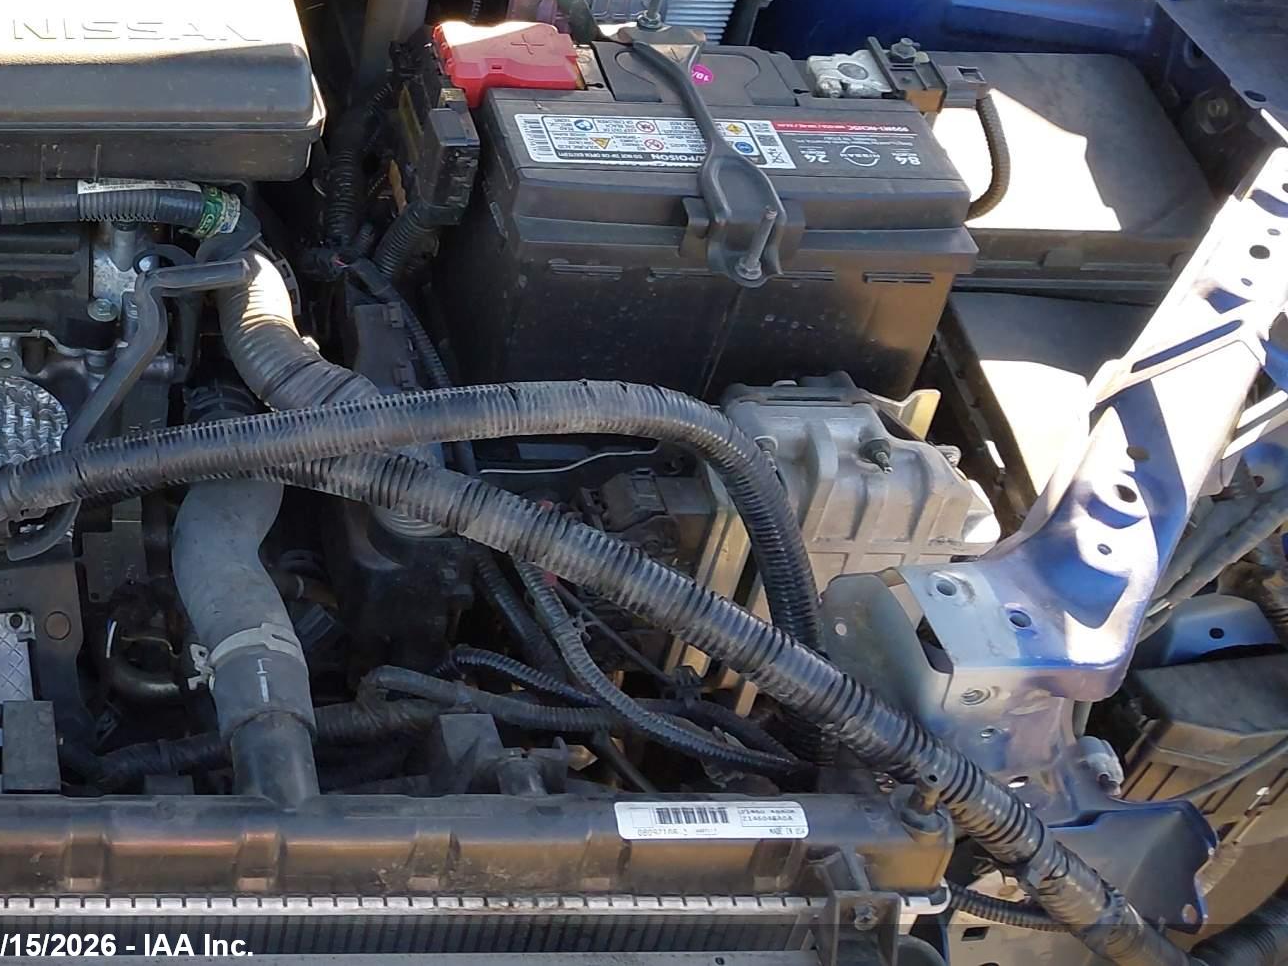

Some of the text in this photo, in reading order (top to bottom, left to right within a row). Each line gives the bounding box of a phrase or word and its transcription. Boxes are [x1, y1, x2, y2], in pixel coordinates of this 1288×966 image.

[12, 18, 262, 41] NISSAN
[803, 154, 830, 163] 24
[895, 156, 921, 165] 84
